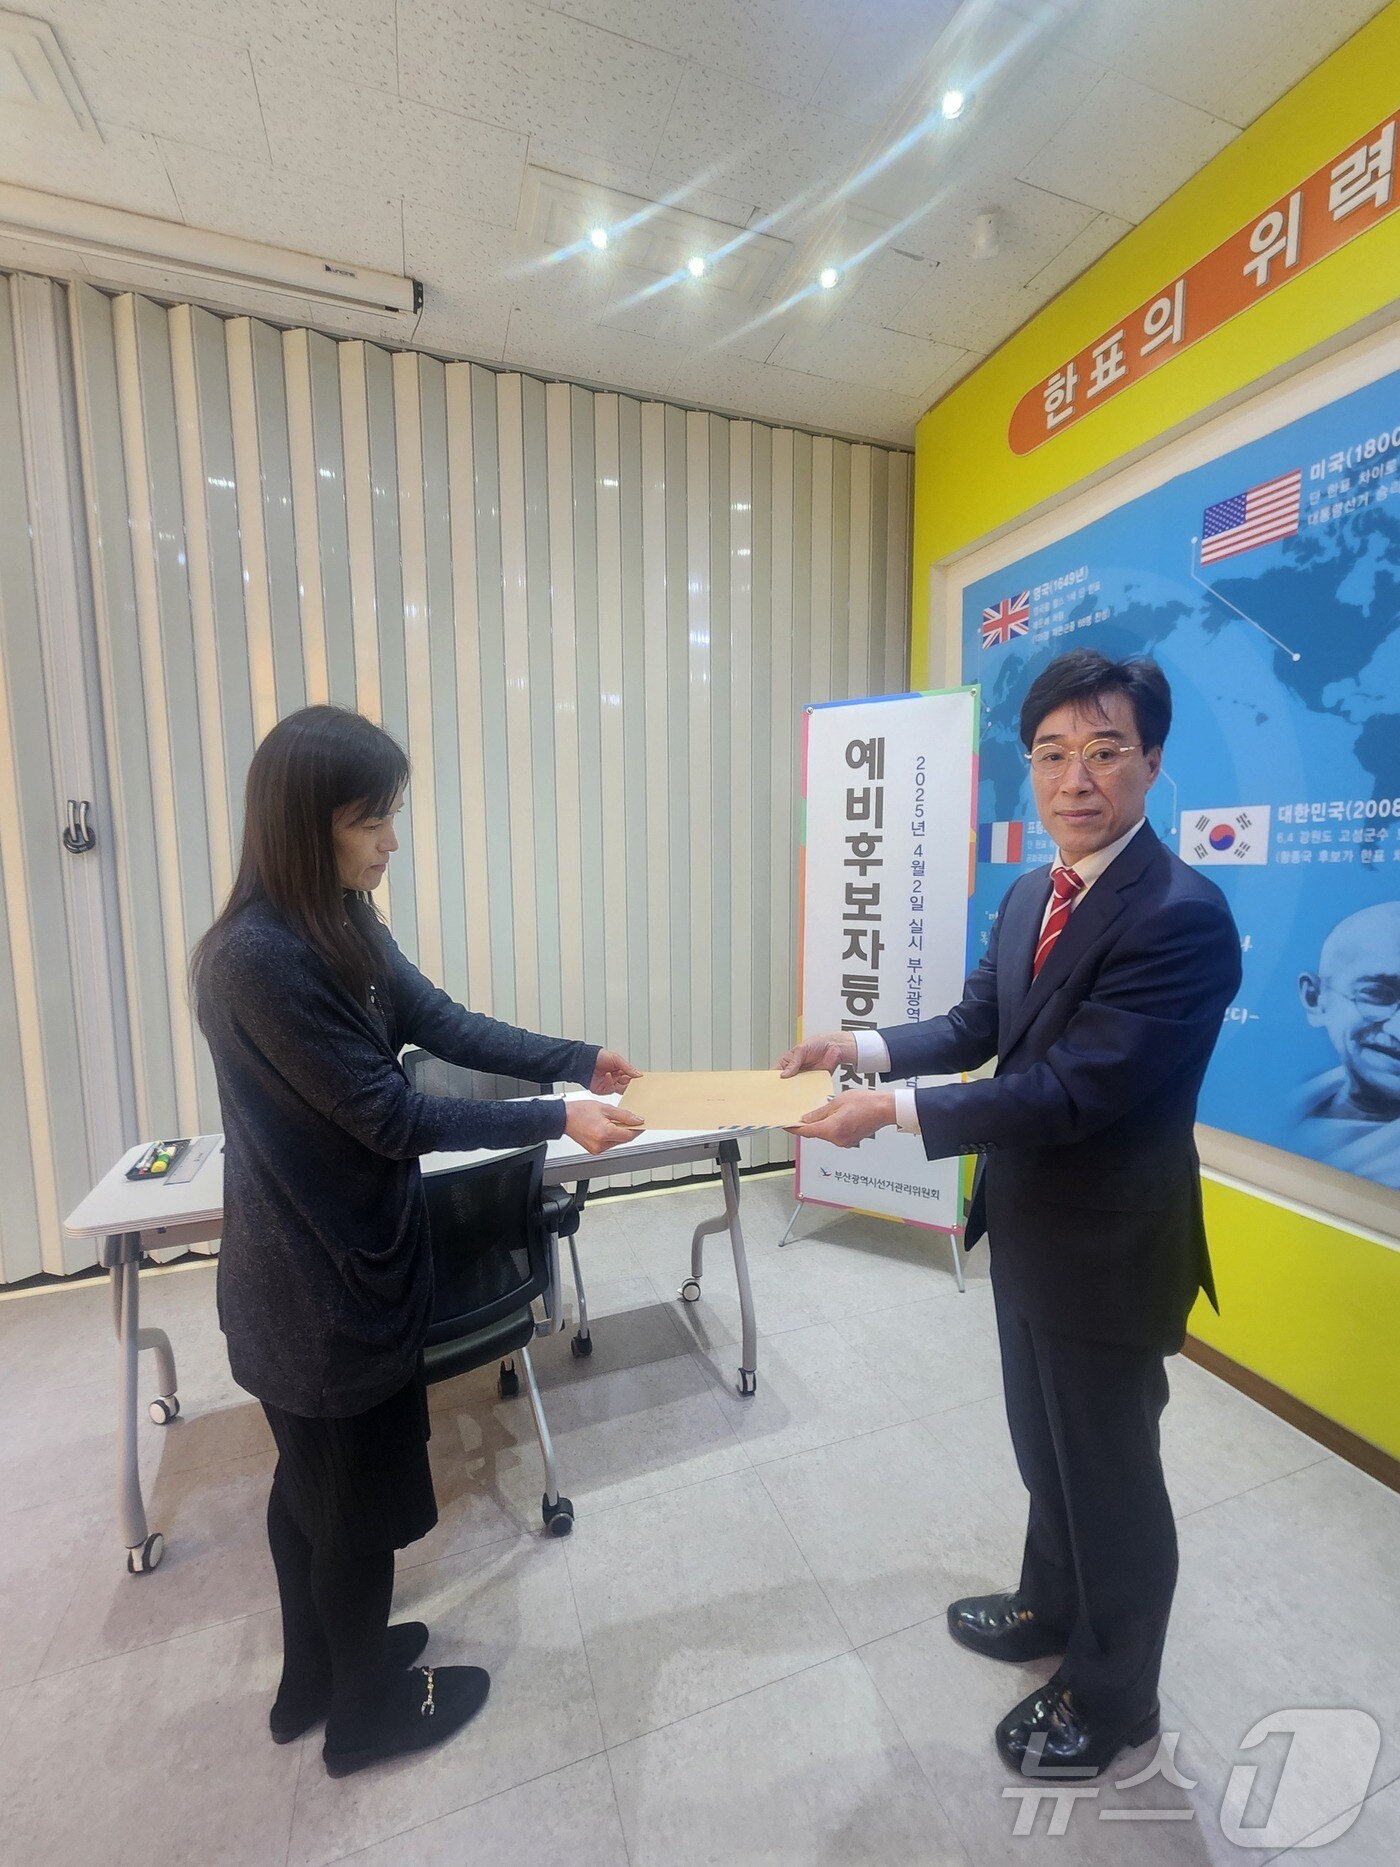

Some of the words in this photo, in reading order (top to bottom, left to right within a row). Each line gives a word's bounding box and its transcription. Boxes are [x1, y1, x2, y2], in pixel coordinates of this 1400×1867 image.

[1043, 278, 1187, 430] 한표의
[1242, 120, 1398, 288] 위력
[1310, 426, 1400, 480] 미국(1800
[911, 756, 925, 837] 2025년
[910, 844, 925, 877] 4월
[909, 879, 924, 912] 2일
[840, 737, 885, 1148] 예비후보자등
[908, 918, 923, 951] 실시
[905, 957, 923, 1024] 부산광역
[834, 1170, 940, 1200] 부산광역시선거관리위원회
